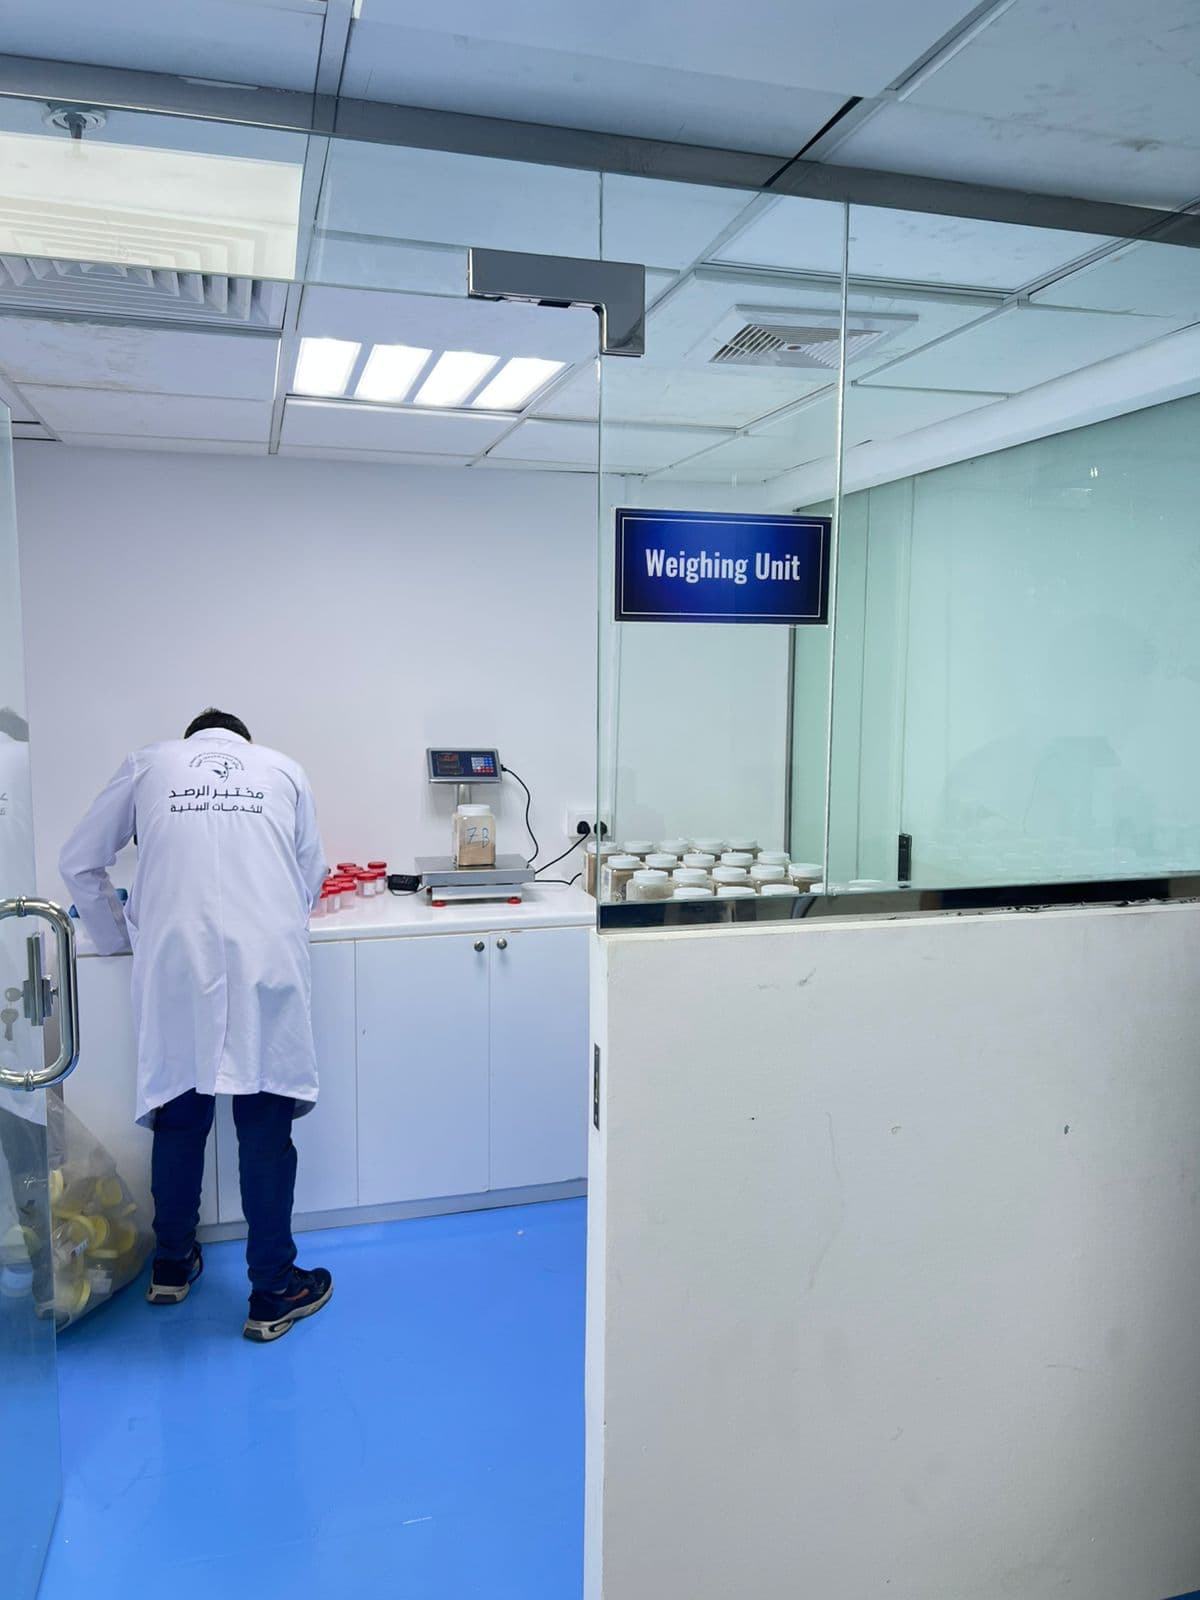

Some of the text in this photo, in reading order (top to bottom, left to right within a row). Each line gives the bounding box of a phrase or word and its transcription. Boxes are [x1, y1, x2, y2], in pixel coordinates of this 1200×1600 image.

[645, 548, 800, 584] Weighing Unit
[169, 785, 264, 799] مختبر الرصد
[212, 803, 263, 814] للخدمات
